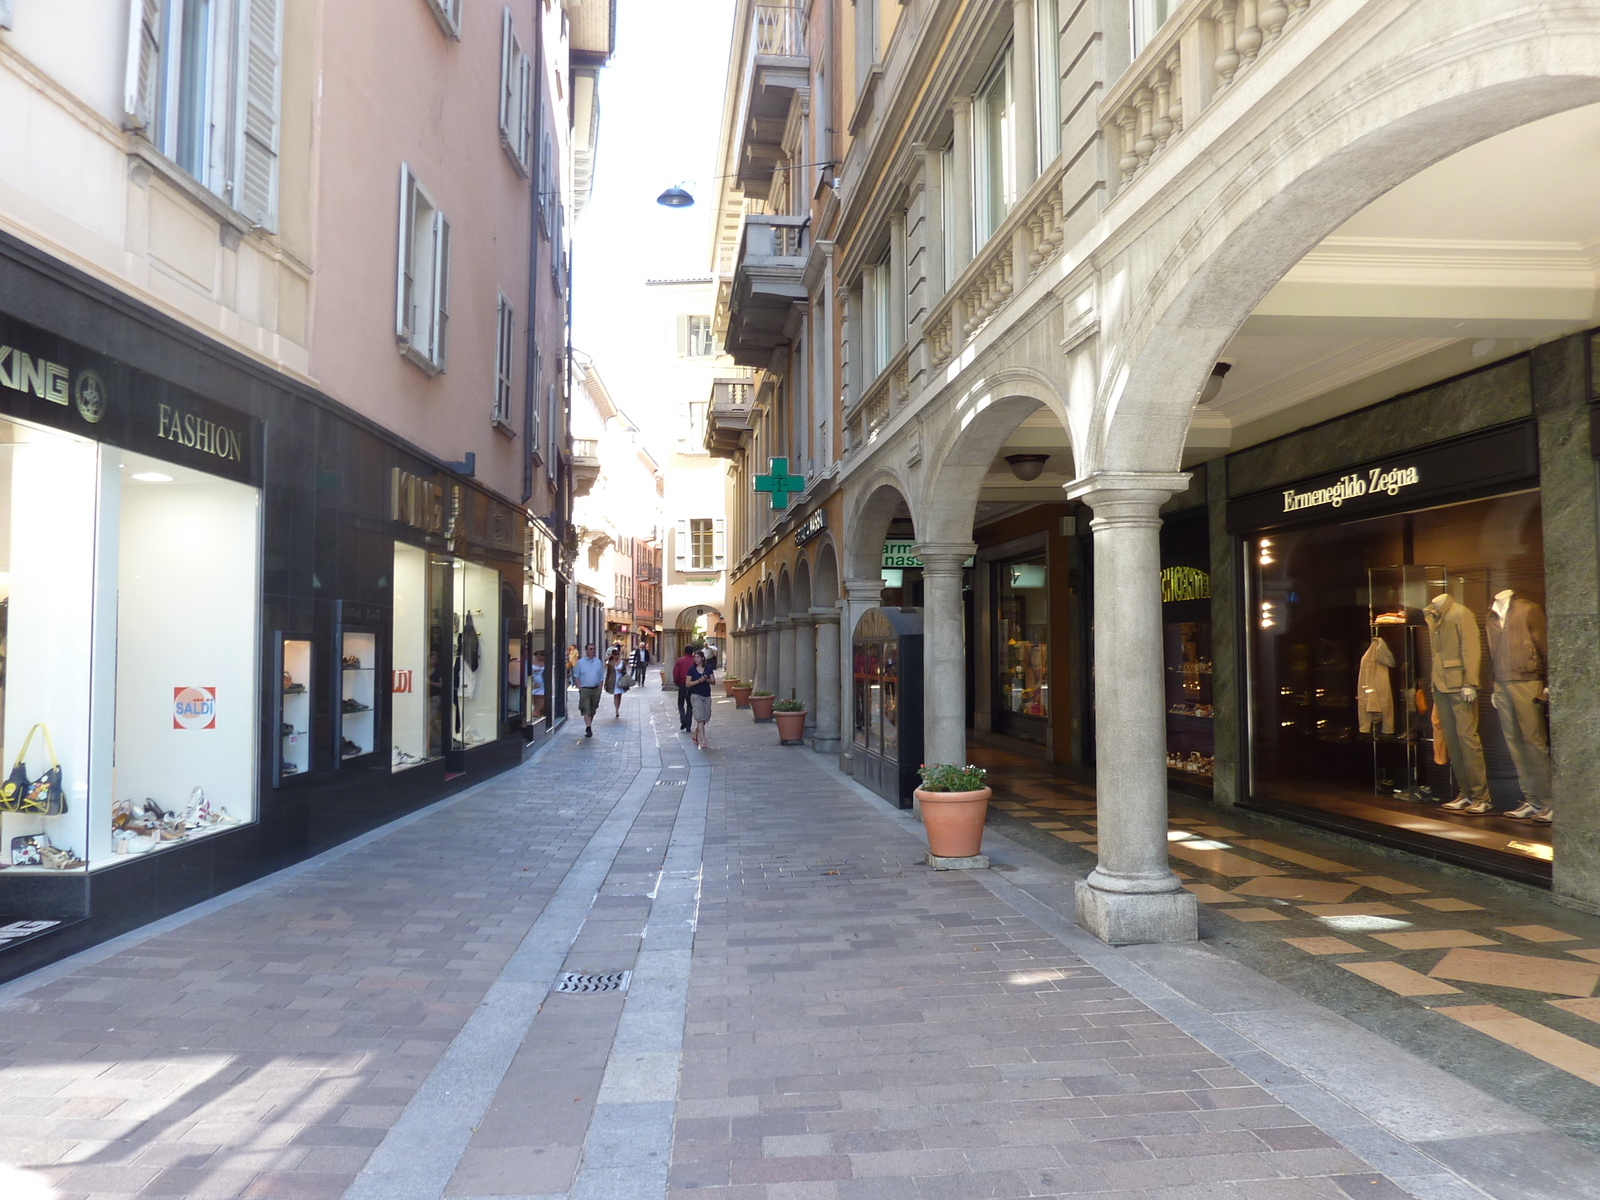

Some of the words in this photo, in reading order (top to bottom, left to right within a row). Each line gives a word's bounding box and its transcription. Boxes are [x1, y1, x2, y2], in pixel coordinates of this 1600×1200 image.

[157, 403, 242, 462] FASHION
[1282, 473, 1366, 513] Ermenegildo
[1368, 466, 1419, 496] Zegna
[884, 555, 924, 567] nass
[391, 670, 413, 693] LDI
[175, 698, 214, 715] SALDI
